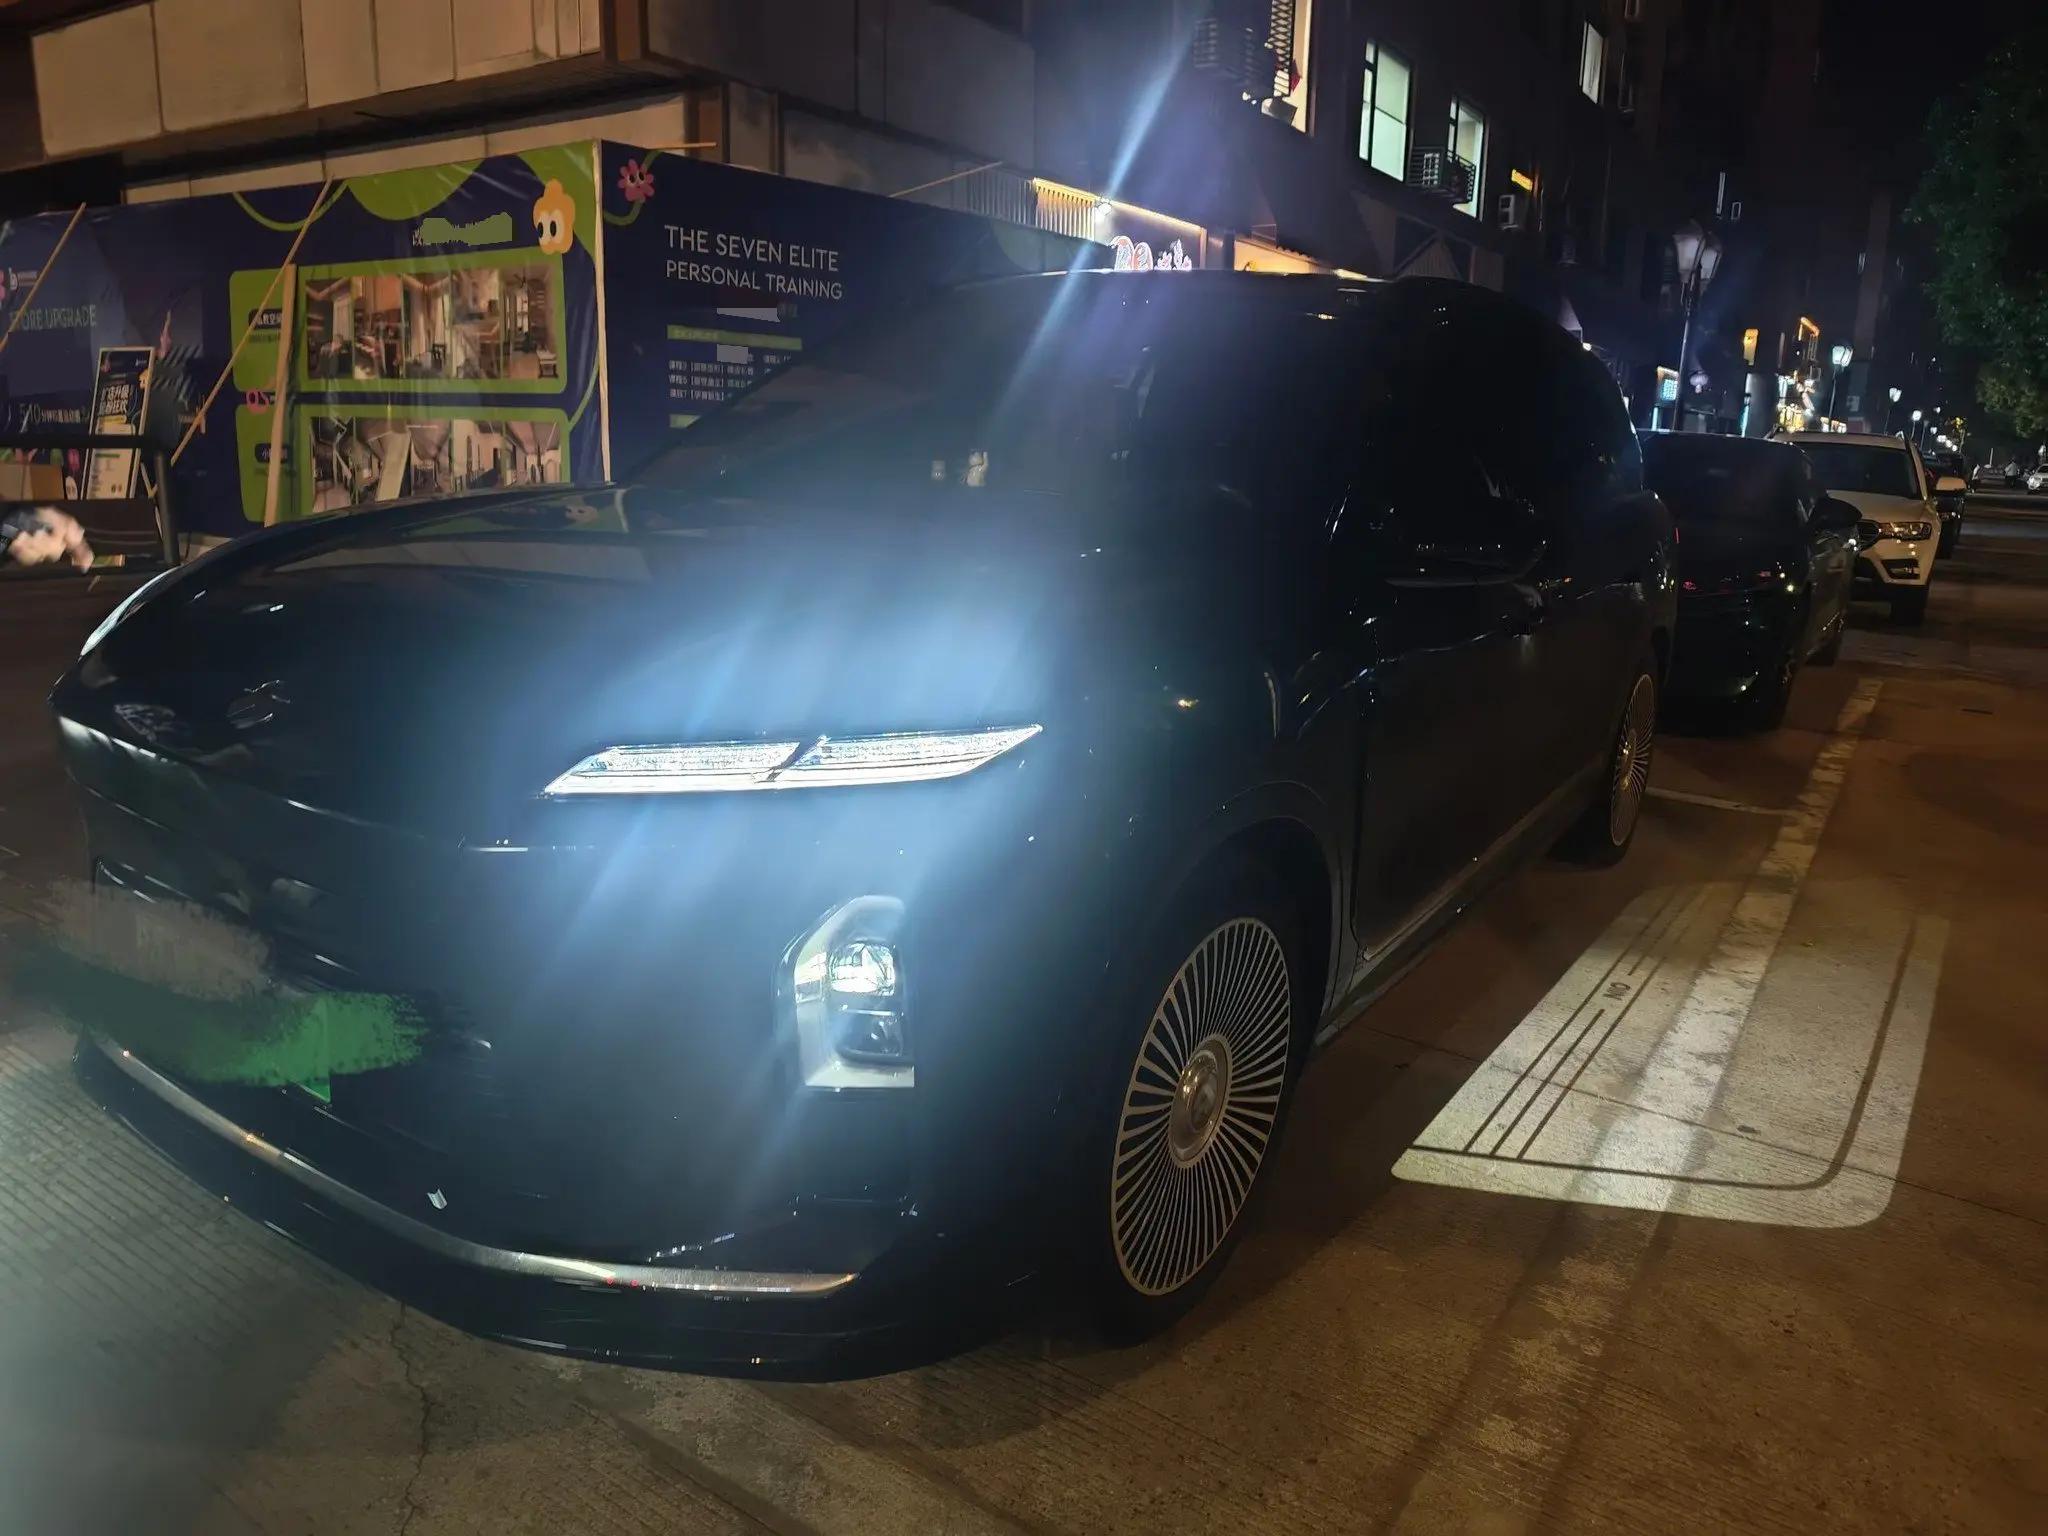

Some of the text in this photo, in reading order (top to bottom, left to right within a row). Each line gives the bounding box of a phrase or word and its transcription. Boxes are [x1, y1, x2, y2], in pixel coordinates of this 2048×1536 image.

[664, 224, 839, 272] THE SEVEN ELITE
[665, 259, 843, 300] PERSONAL TRAINING
[45, 304, 97, 329] UPGRADE
